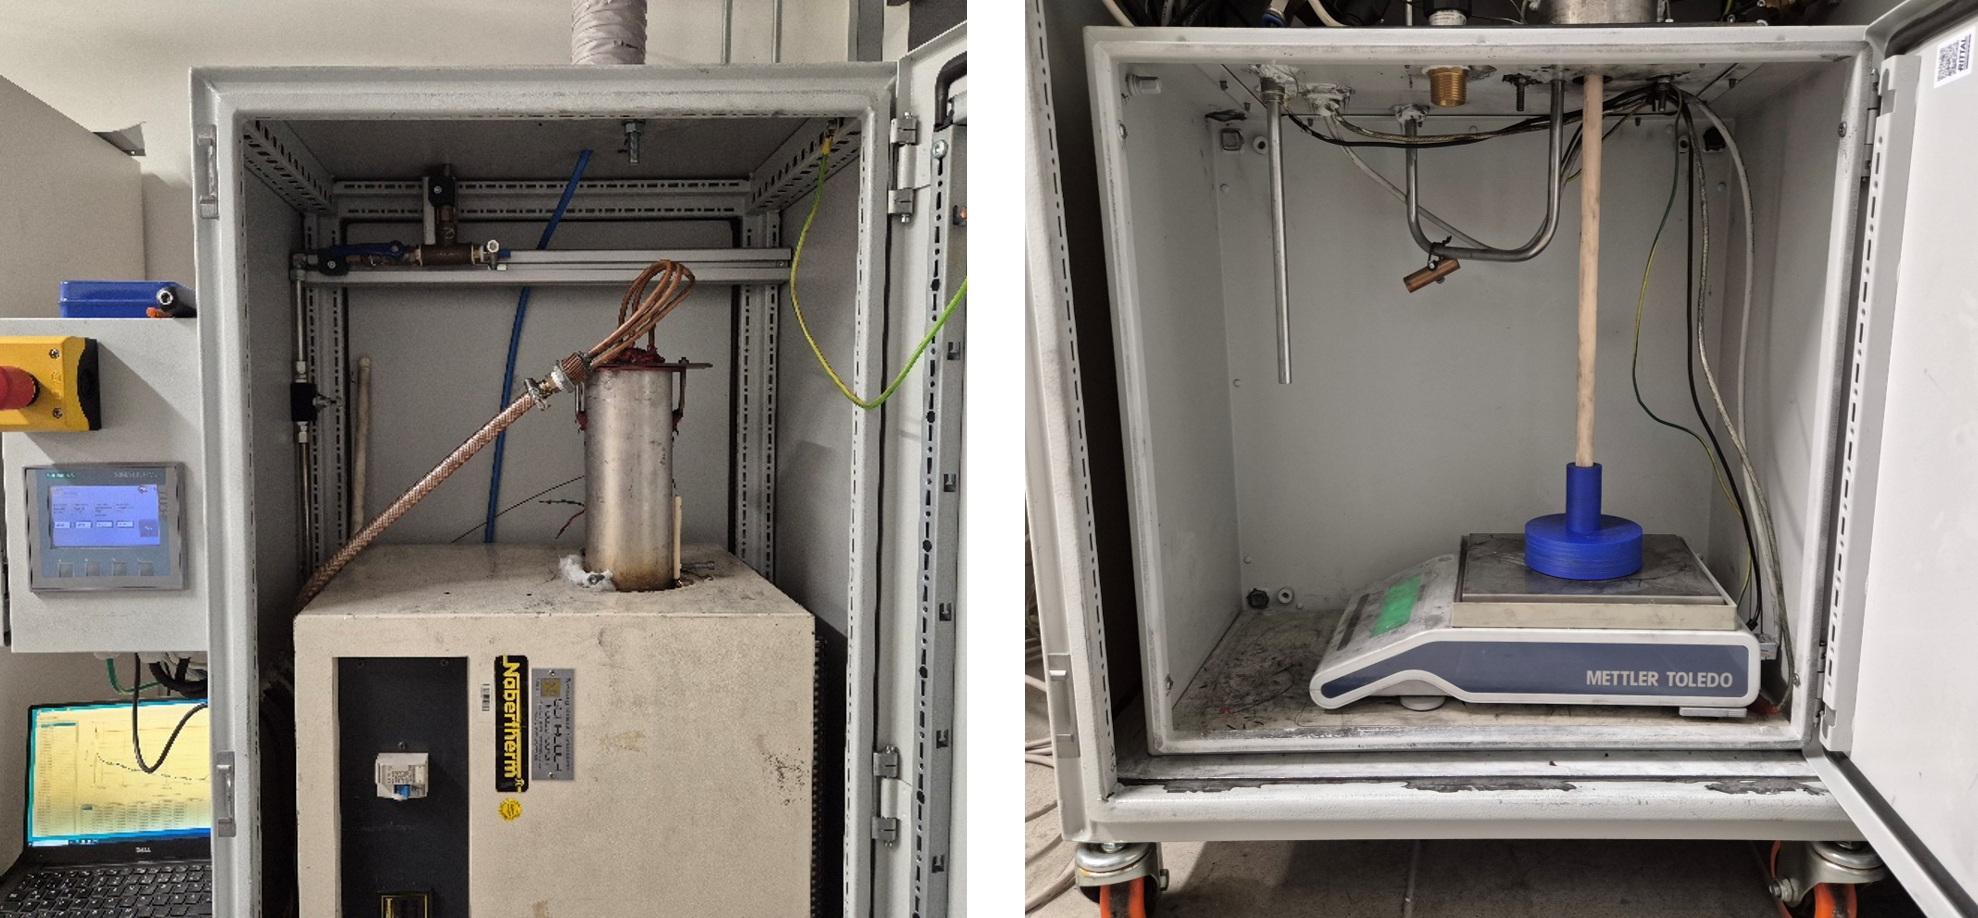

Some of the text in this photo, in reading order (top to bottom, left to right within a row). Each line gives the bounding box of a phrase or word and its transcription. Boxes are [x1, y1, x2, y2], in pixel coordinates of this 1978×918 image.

[1958, 38, 1967, 71] RITTAL
[1586, 670, 1733, 688] METTLER TOLEDO
[503, 656, 522, 779] Nabertherm
